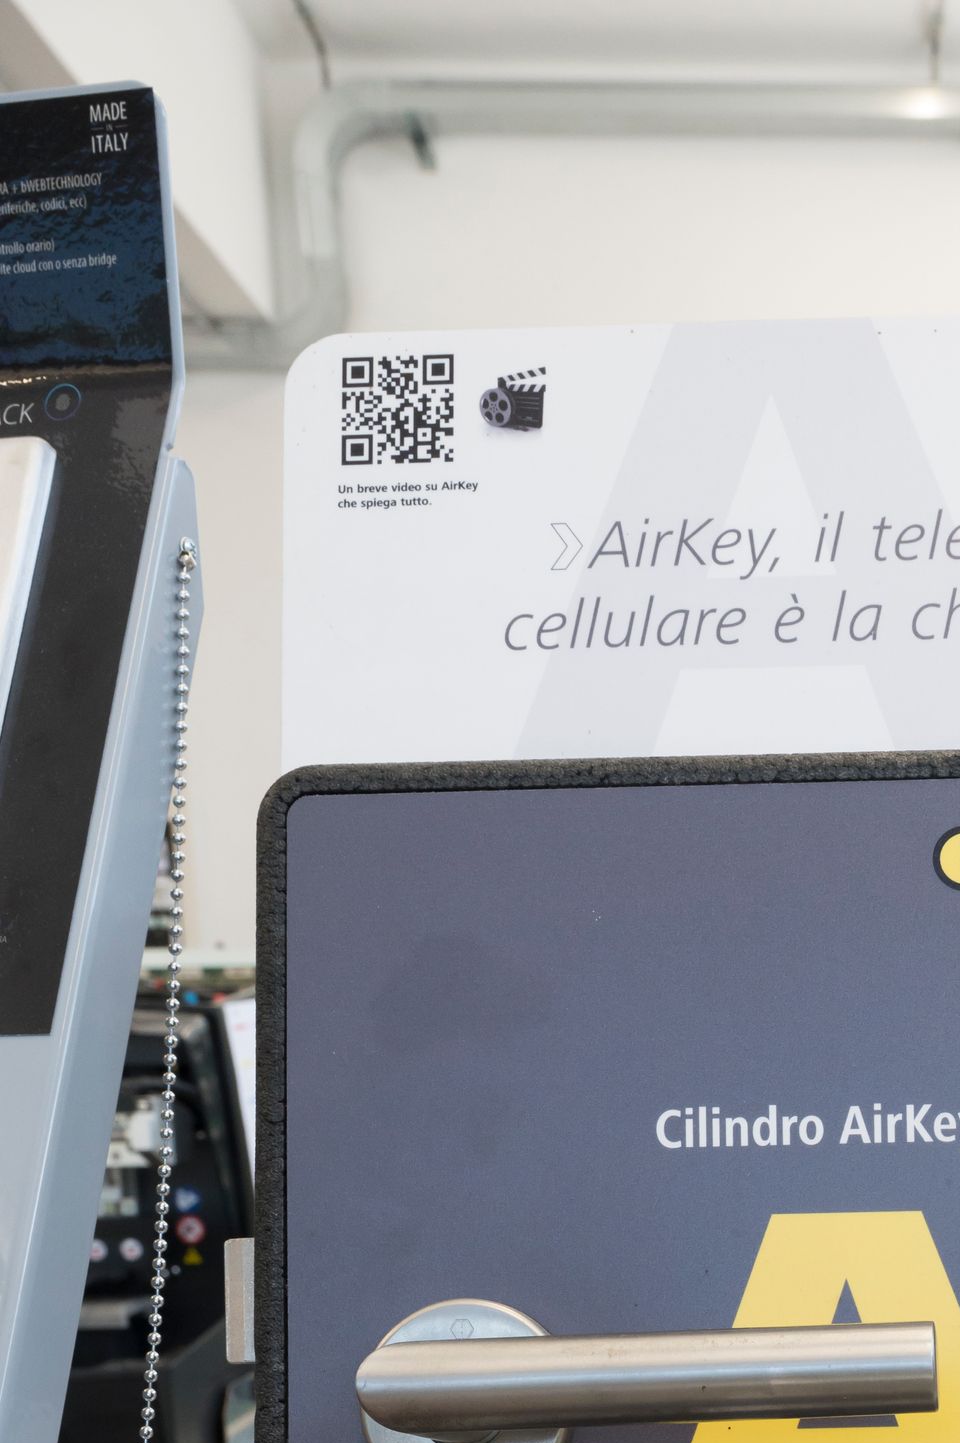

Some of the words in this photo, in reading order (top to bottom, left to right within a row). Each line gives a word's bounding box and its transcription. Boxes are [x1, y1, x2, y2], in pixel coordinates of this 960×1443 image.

[90, 101, 127, 122] MADE
[92, 132, 128, 153] ITALY
[338, 485, 353, 494] Un
[357, 484, 388, 494] breve
[391, 482, 422, 492] video
[441, 481, 478, 492] AirKey
[338, 499, 357, 508] che
[361, 498, 397, 510] spiega
[400, 496, 432, 508] tutto.
[587, 518, 780, 581] AirKey,
[814, 511, 844, 562] il
[504, 595, 747, 651] cellulare
[774, 593, 805, 644] è
[832, 590, 882, 642] la
[656, 1105, 824, 1149] Cilindro
